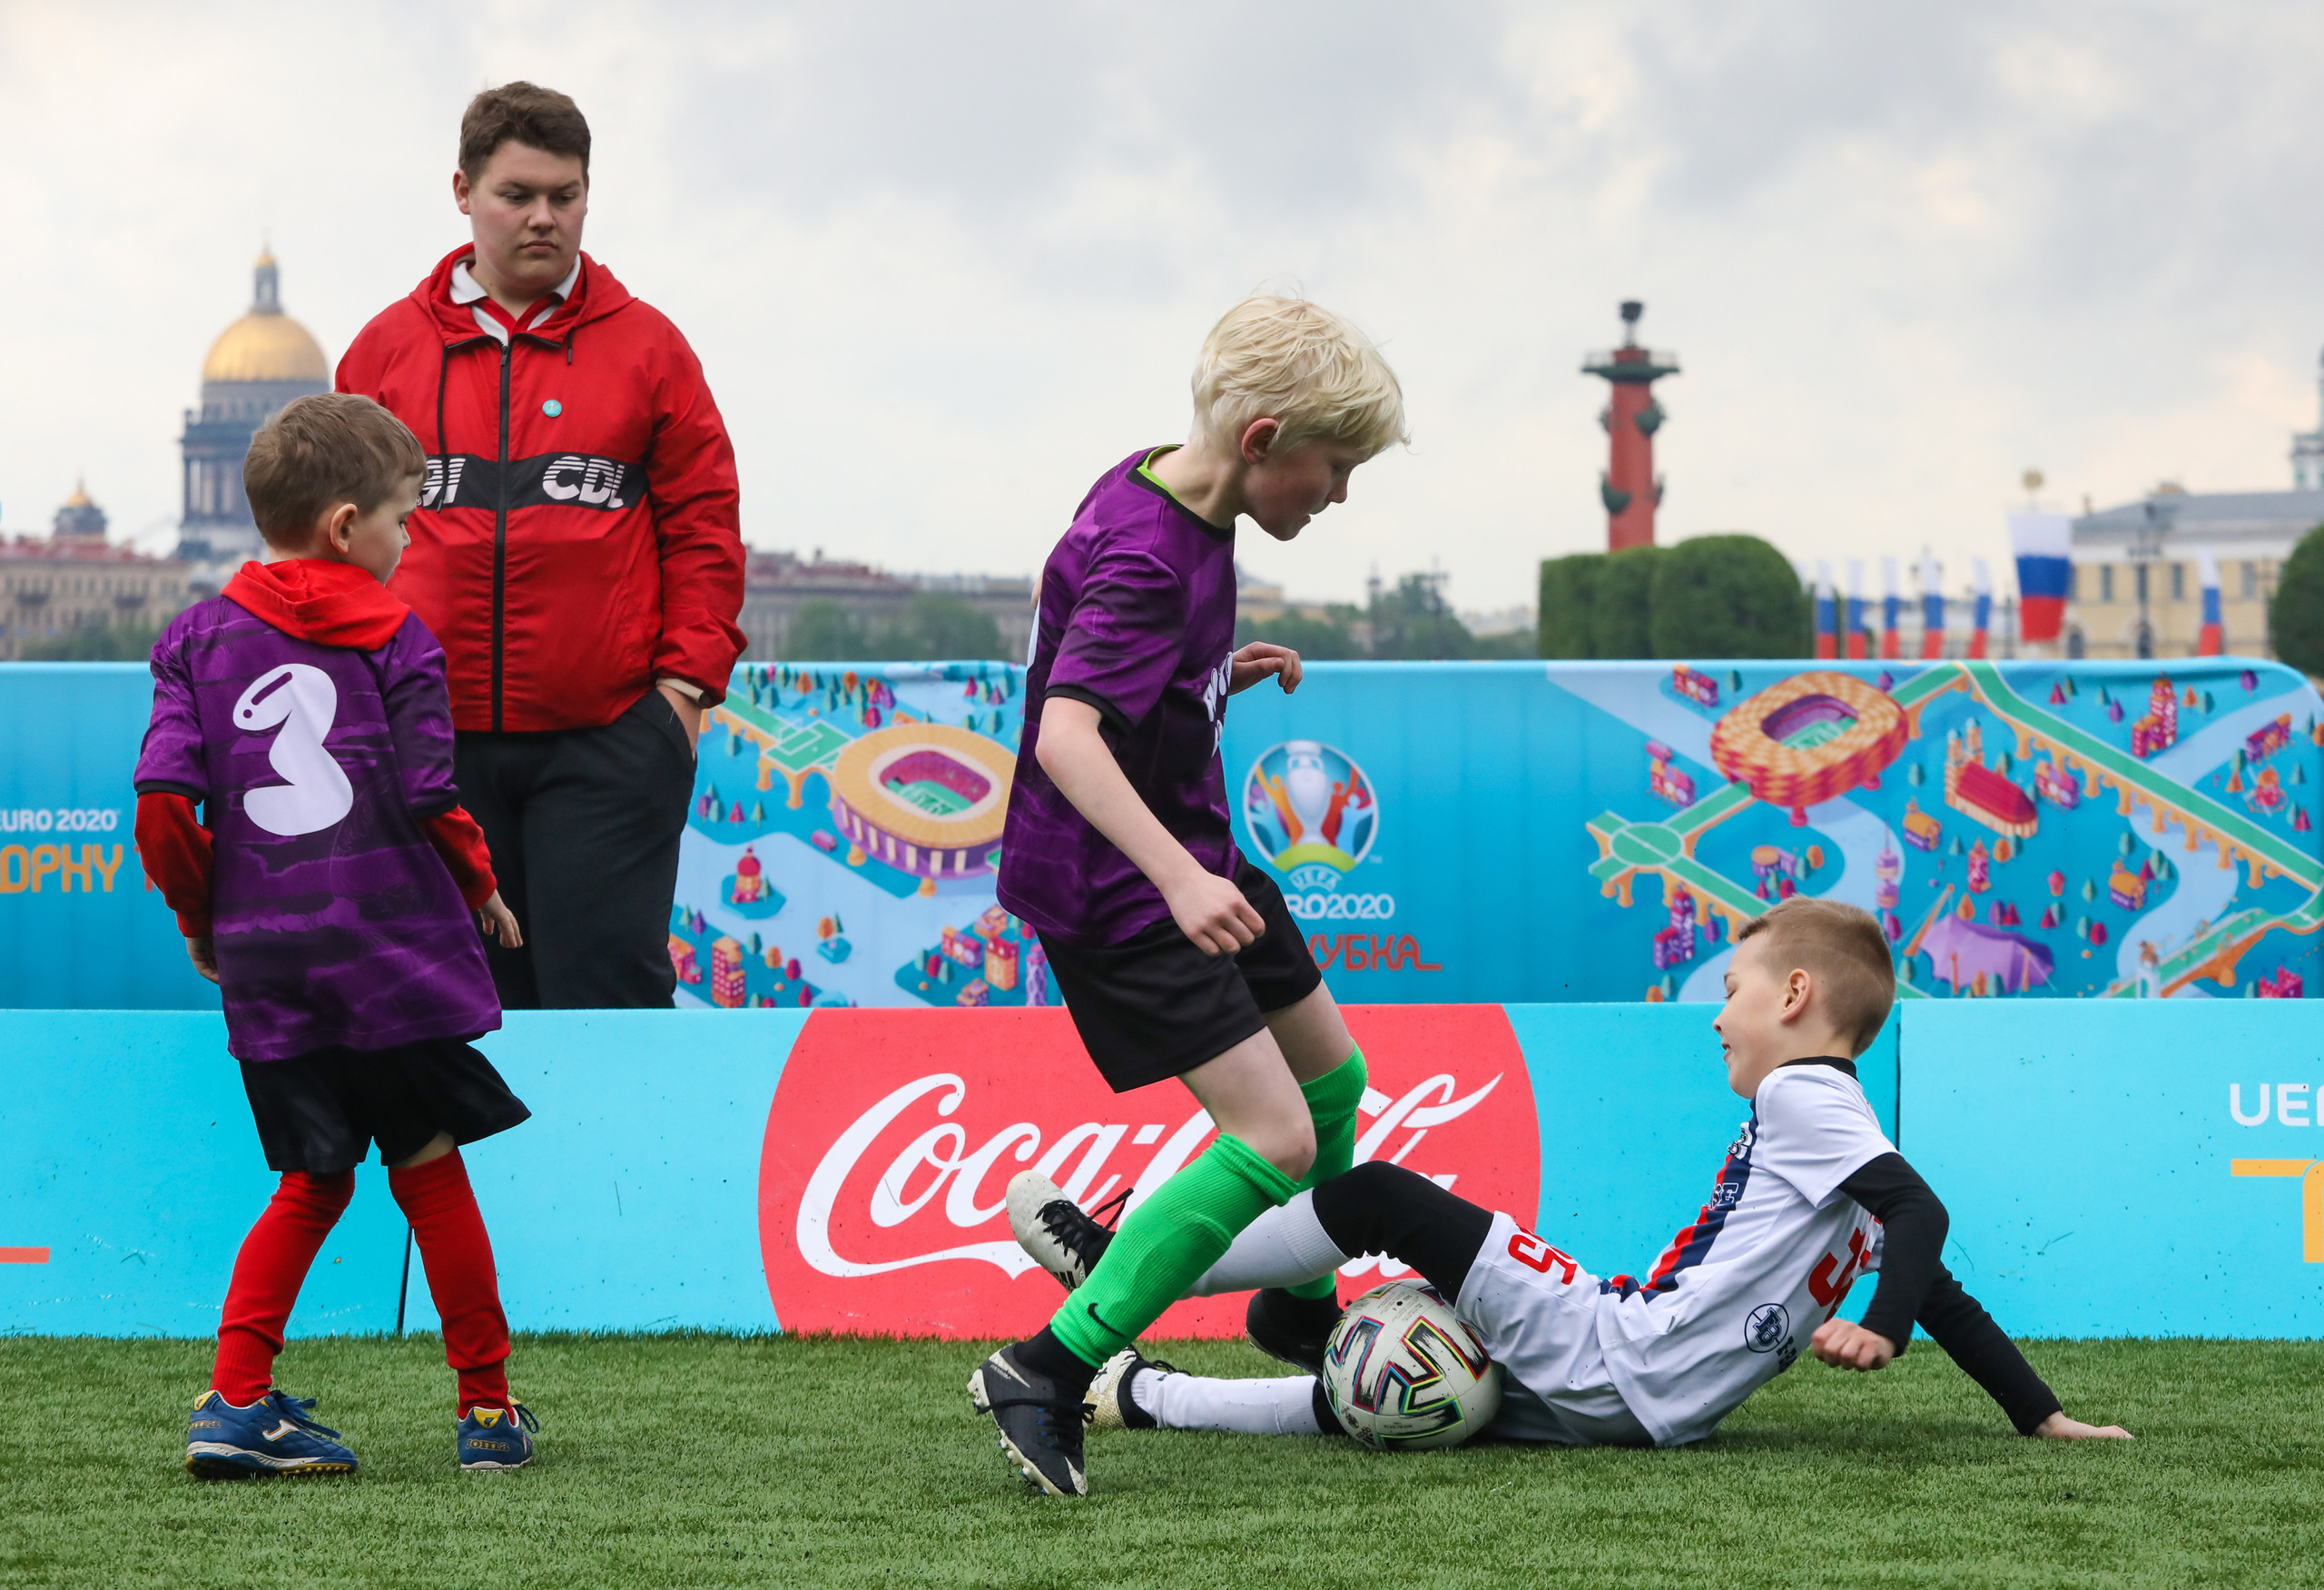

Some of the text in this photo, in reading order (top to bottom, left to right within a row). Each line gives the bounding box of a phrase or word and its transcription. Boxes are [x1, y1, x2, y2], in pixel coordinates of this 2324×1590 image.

[232, 663, 354, 836] 3
[0, 809, 118, 832] URO 2020
[1288, 864, 1343, 893] UEFA
[2230, 1083, 2324, 1126] UE
